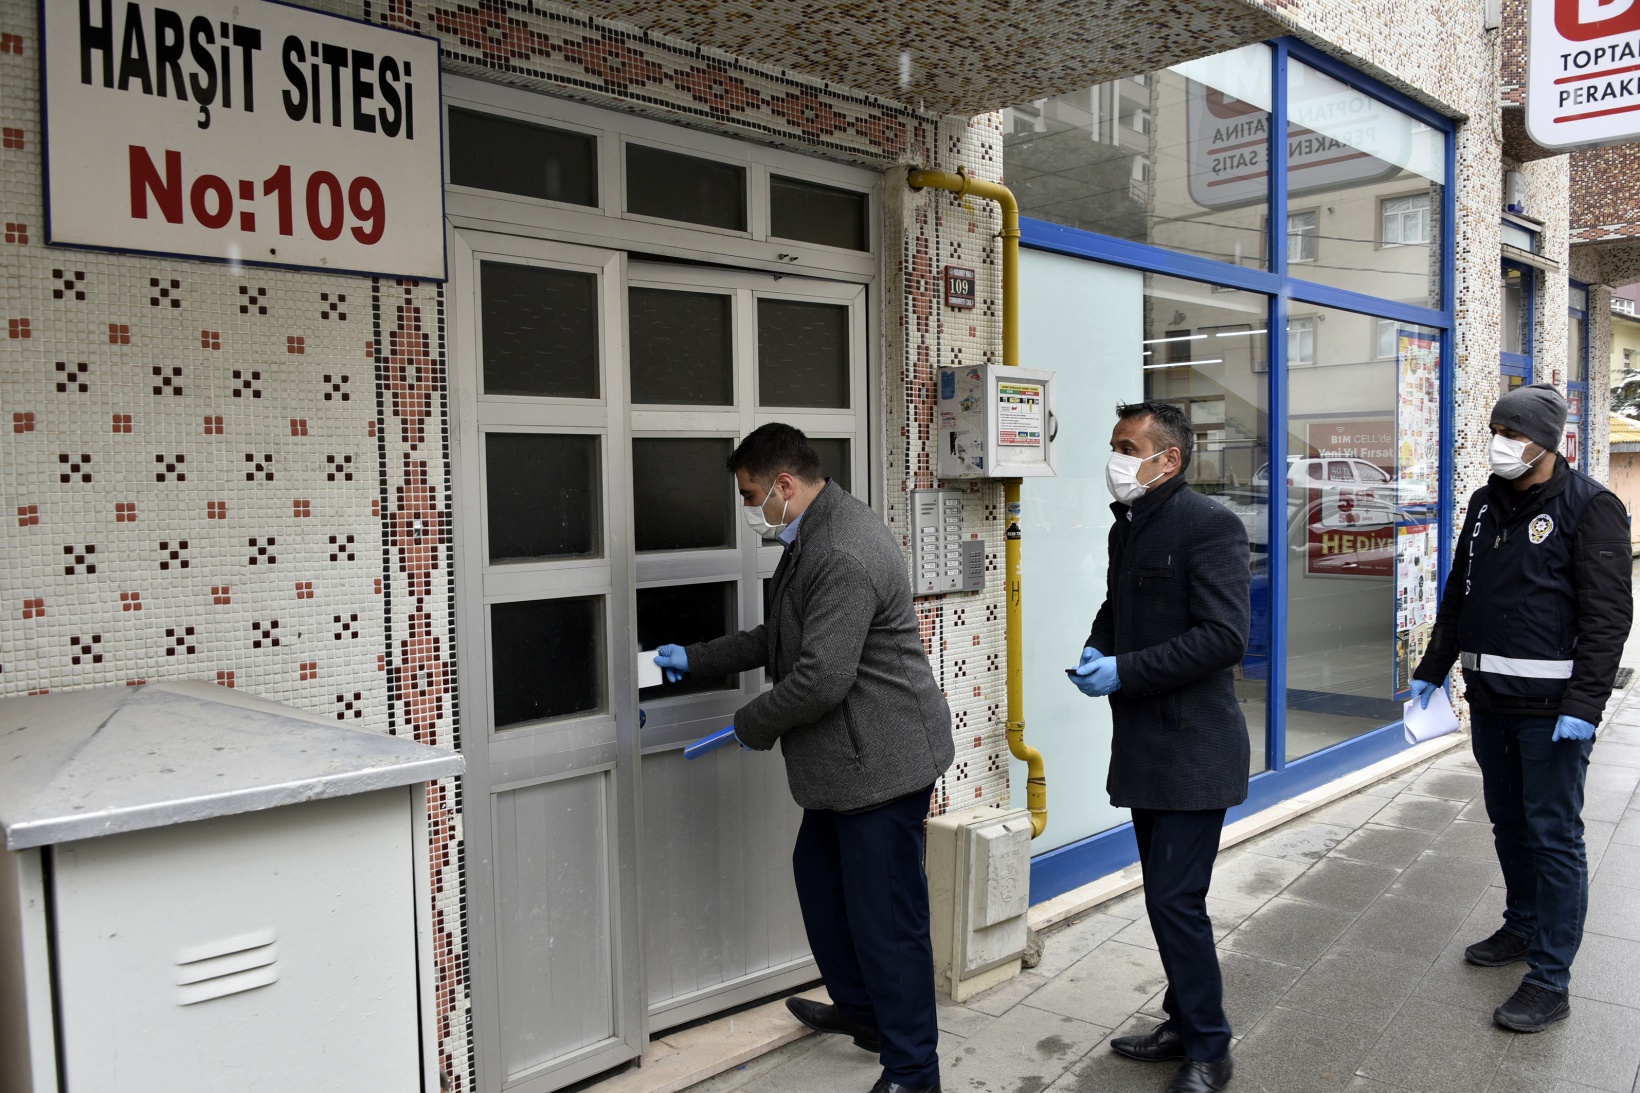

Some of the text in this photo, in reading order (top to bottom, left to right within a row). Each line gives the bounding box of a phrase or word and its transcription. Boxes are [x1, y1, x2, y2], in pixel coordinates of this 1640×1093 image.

[1560, 40, 1640, 71] TOPTA
[128, 144, 386, 245] No:109
[950, 278, 968, 295] 109
[1318, 448, 1341, 458] Yeni
[1337, 488, 1355, 513] 5
[1465, 504, 1489, 596] POLİS
